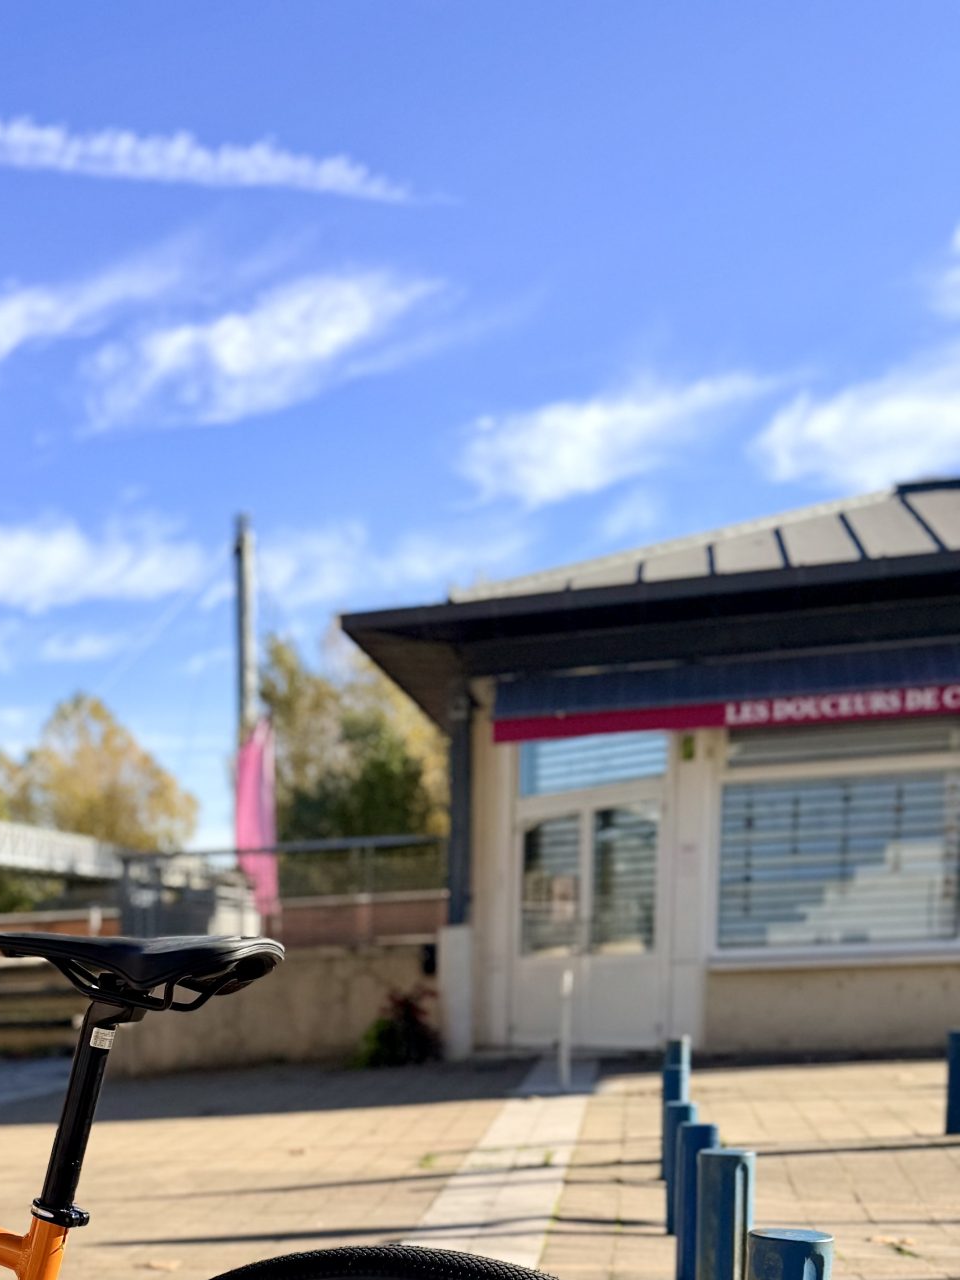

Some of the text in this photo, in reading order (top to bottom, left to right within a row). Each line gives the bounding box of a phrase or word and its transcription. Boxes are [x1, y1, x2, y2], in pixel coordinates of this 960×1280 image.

[726, 700, 770, 725] LES
[772, 690, 901, 721] DOUCEURS
[904, 687, 938, 711] DE
